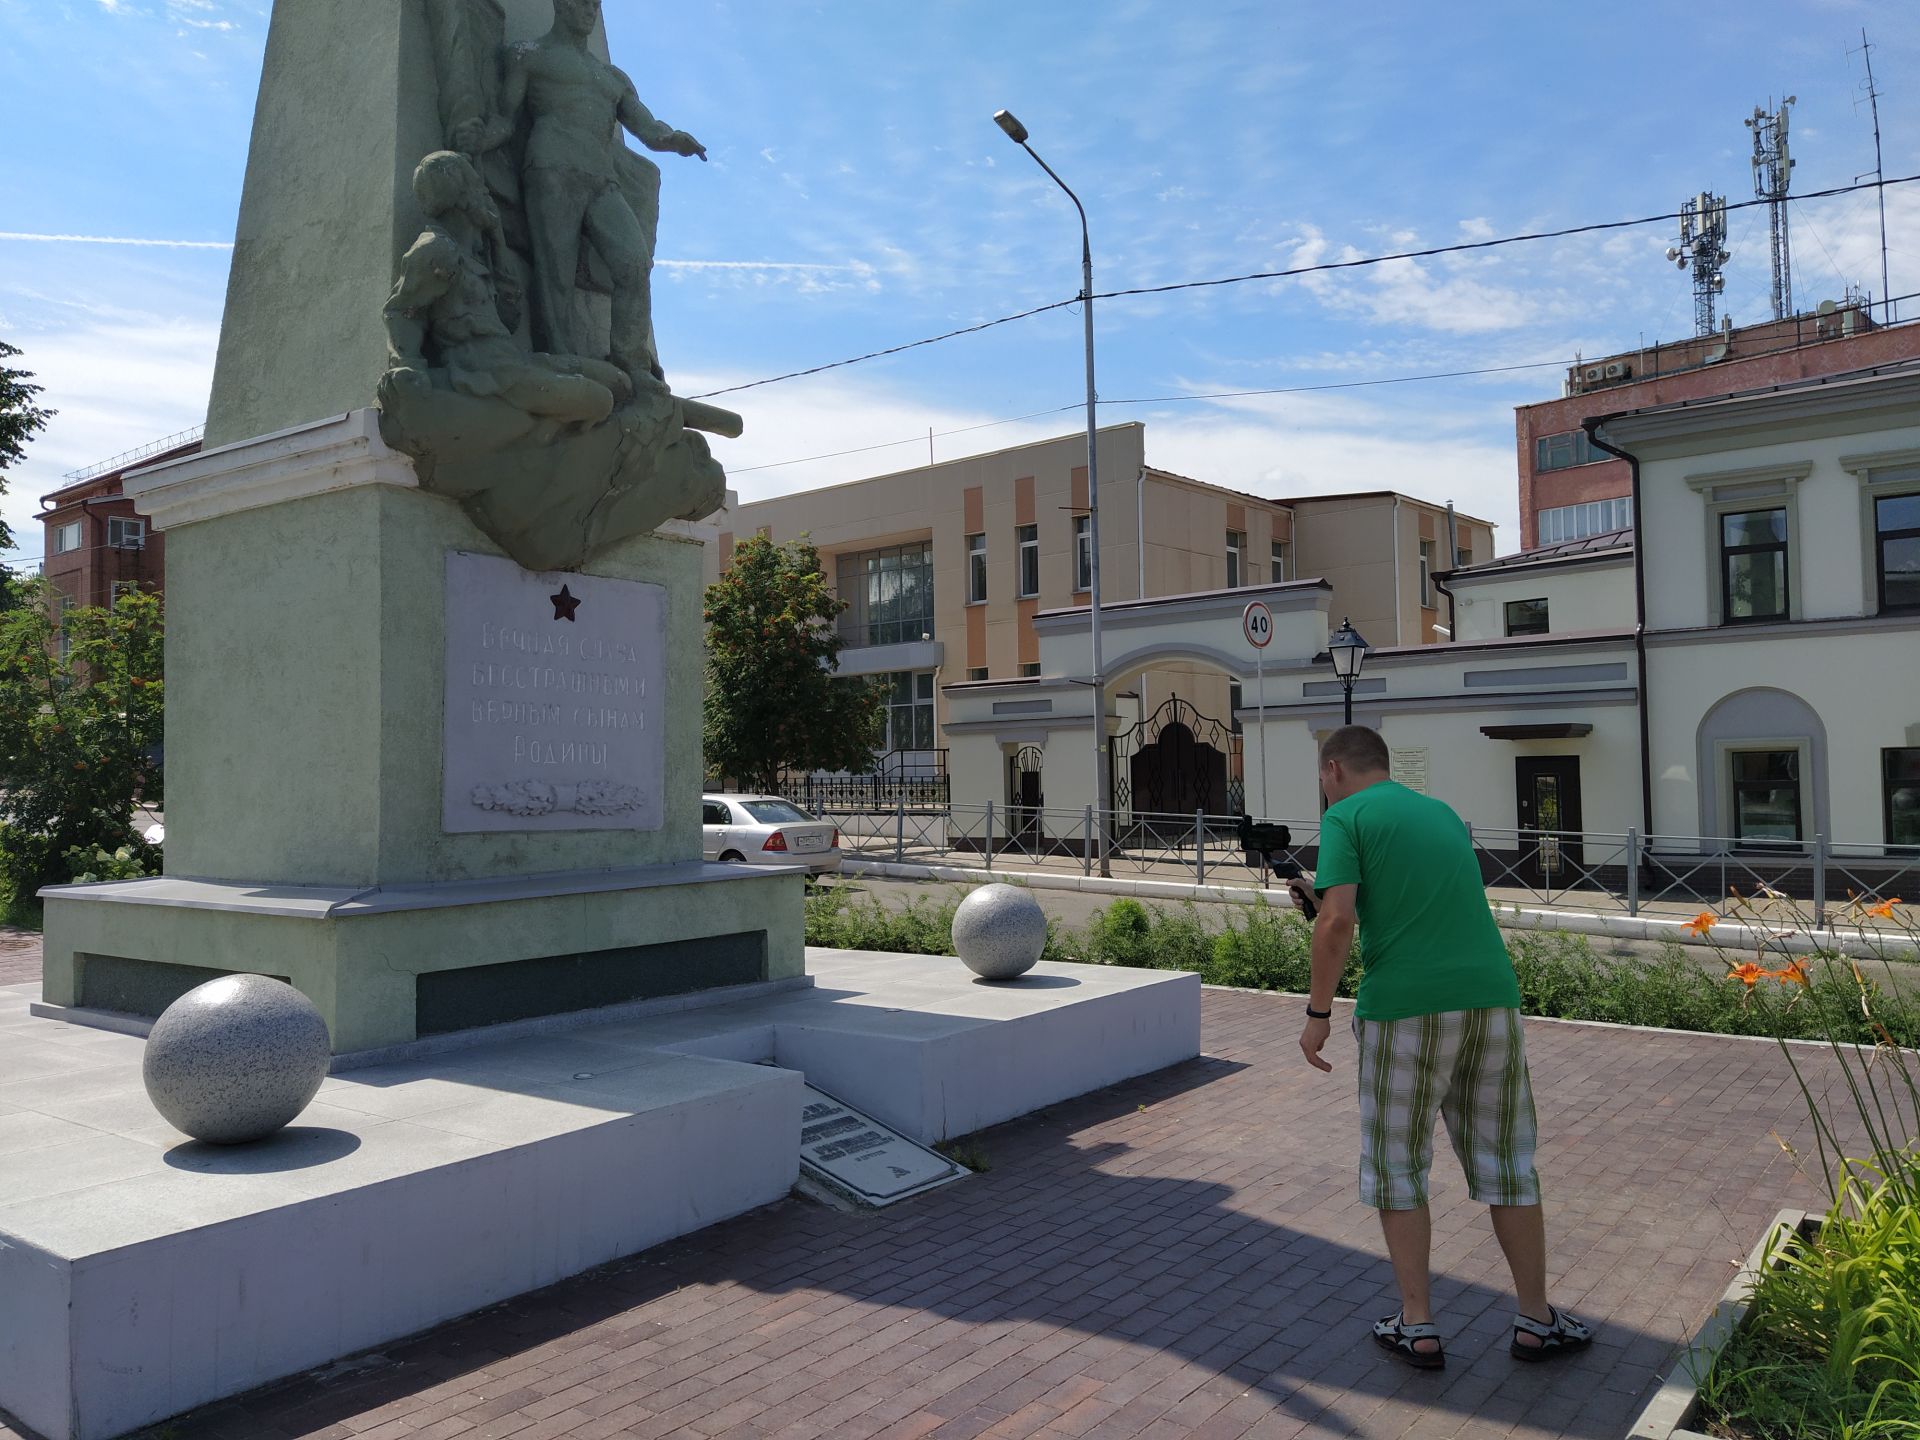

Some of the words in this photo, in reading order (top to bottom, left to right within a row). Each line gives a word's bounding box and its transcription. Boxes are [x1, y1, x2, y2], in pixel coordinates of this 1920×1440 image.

[1251, 616, 1268, 633] 40
[472, 697, 561, 727] ВЕРНЫМ
[573, 707, 646, 731] СЫНАМ
[514, 735, 608, 769] РОДИНЫ
